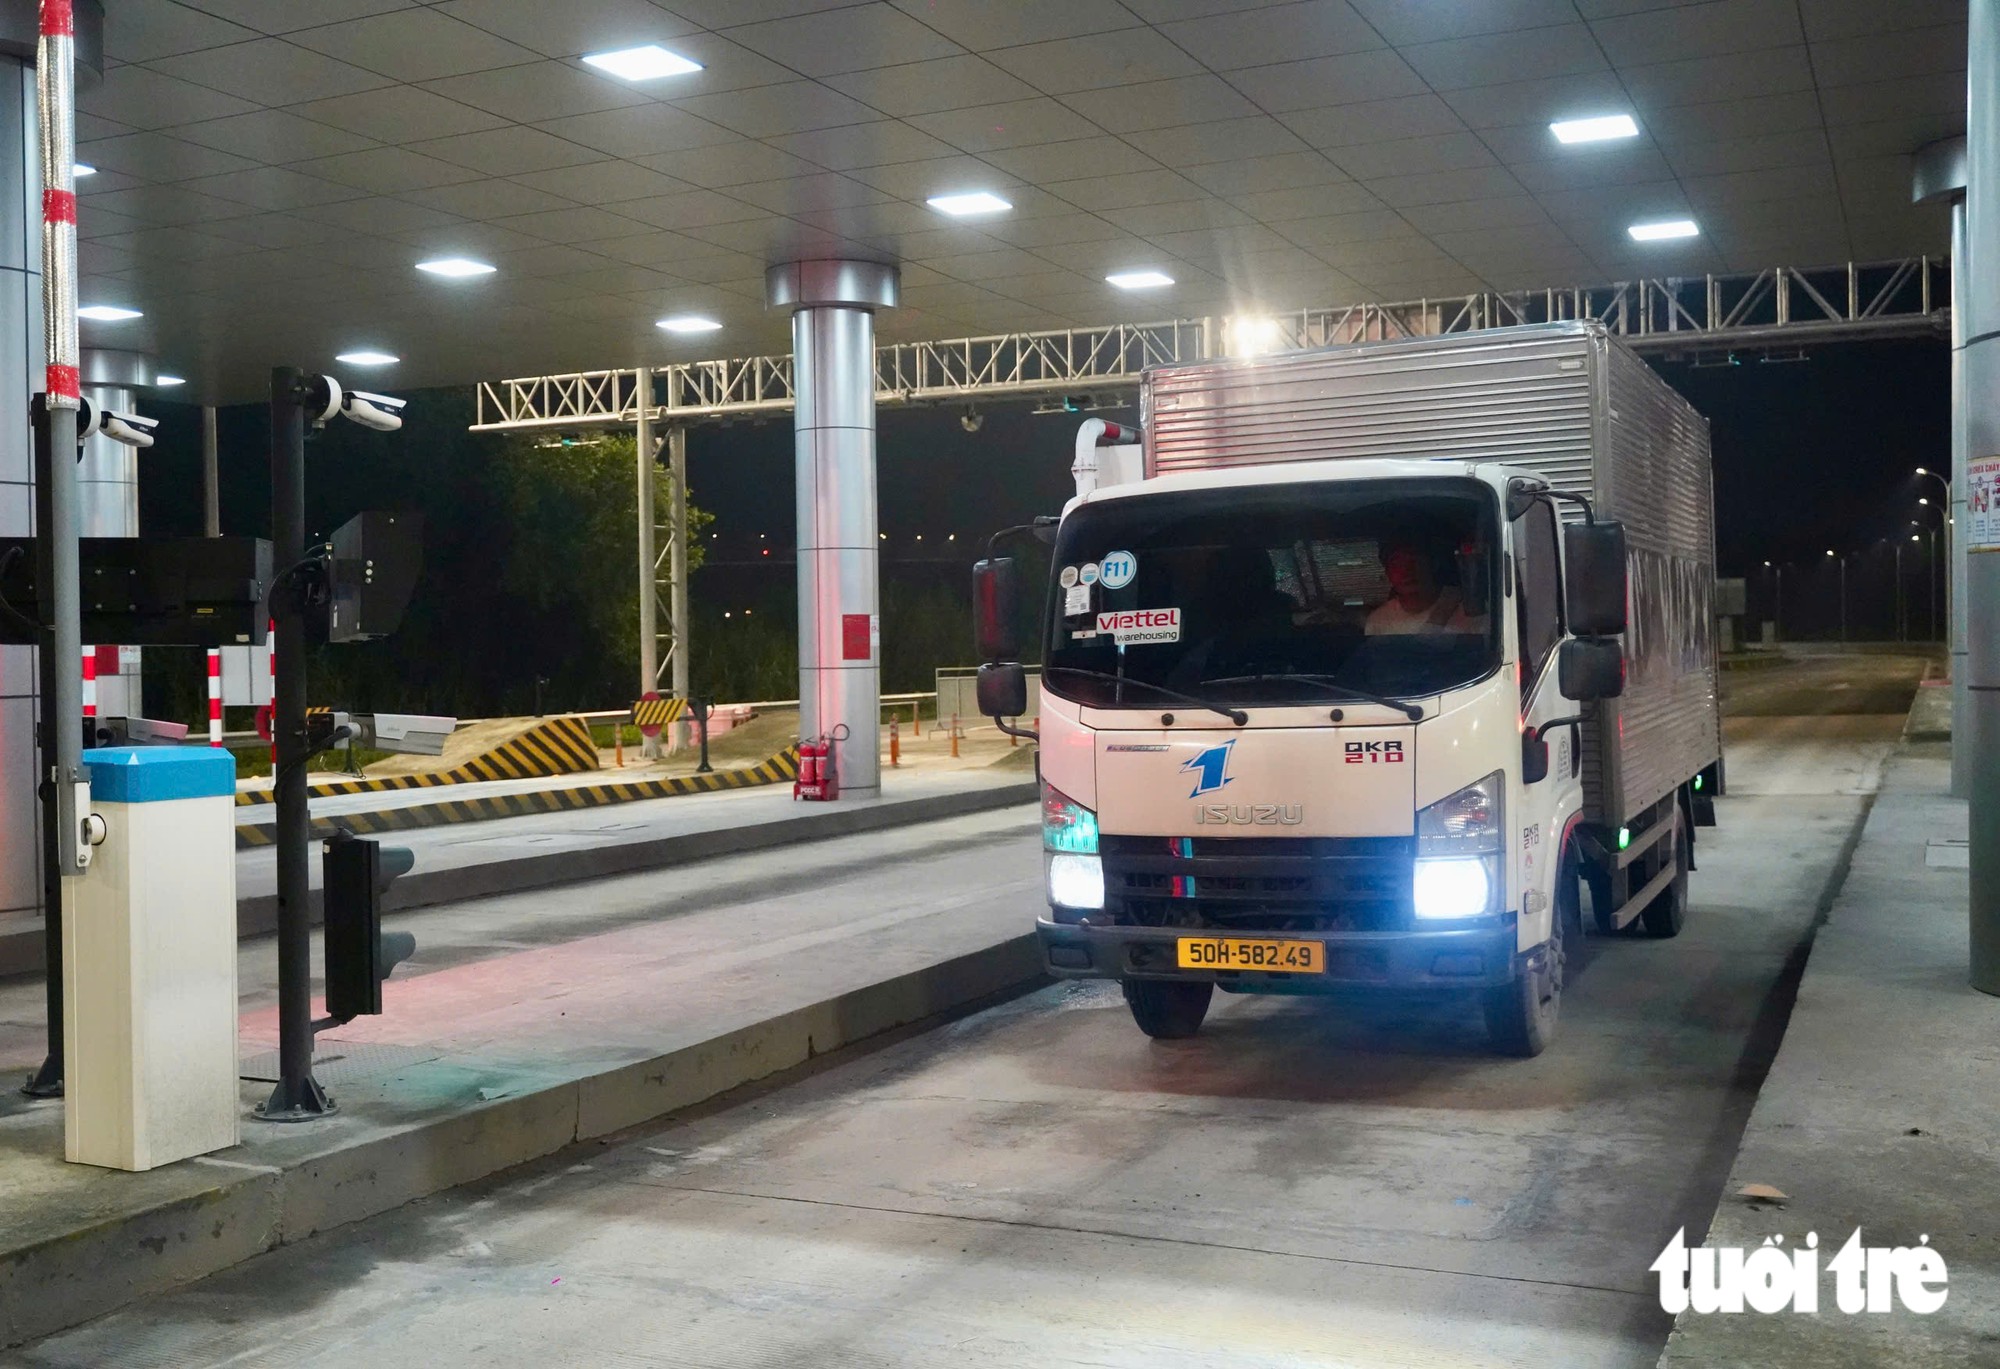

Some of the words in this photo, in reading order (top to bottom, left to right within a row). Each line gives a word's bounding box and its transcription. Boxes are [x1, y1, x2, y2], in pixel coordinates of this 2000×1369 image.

[1104, 561, 1129, 578] F11
[1099, 610, 1178, 630] viettel
[1116, 631, 1178, 642] warehousing
[1345, 741, 1403, 752] QKR
[1345, 752, 1404, 763] 210
[1195, 804, 1303, 825] ISUZU
[1523, 823, 1539, 838] QKR
[1523, 834, 1539, 849] 210
[1190, 943, 1311, 967] 50H-582.49
